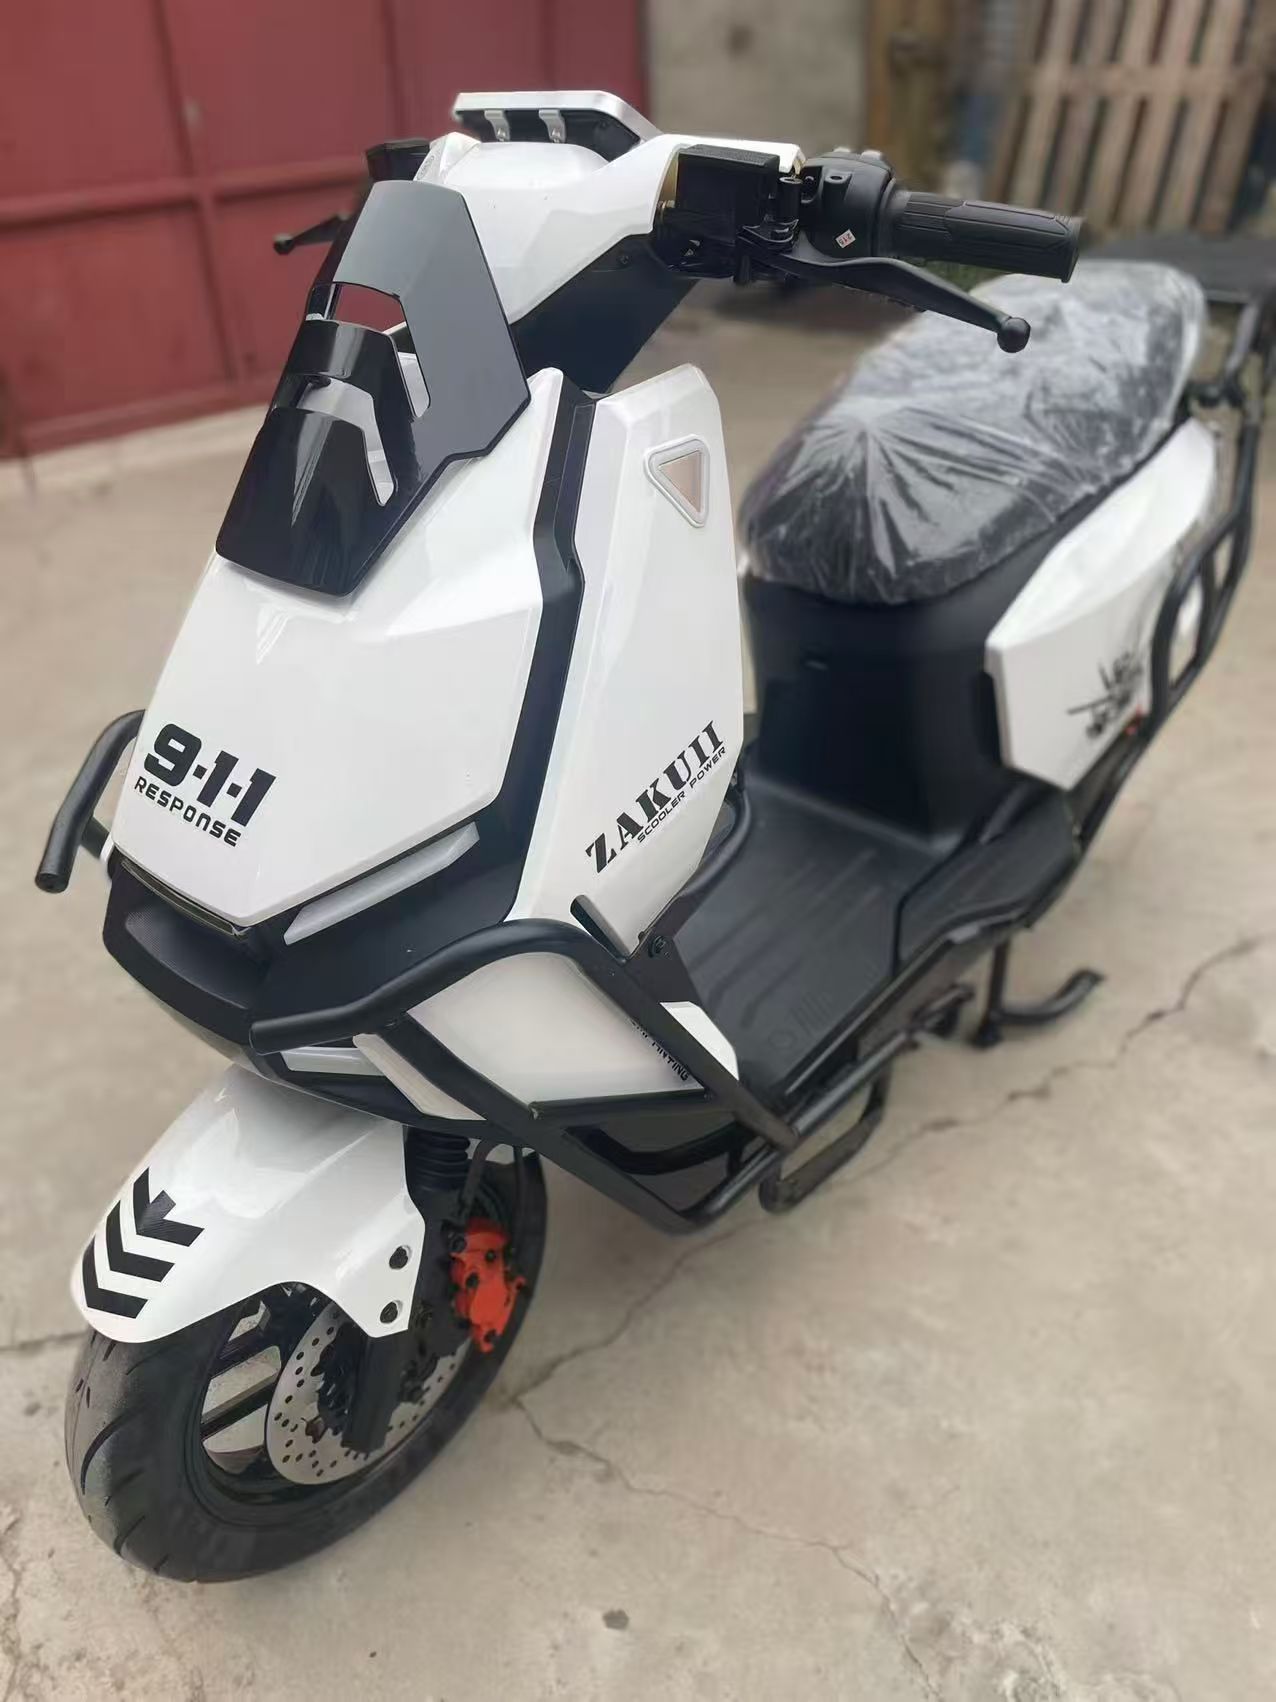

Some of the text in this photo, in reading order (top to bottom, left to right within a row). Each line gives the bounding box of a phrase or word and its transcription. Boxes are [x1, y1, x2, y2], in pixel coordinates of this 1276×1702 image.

[134, 775, 242, 848] RESPONSE
[585, 720, 724, 874] ZAKUII
[637, 746, 726, 843] SCOOLER POWER
